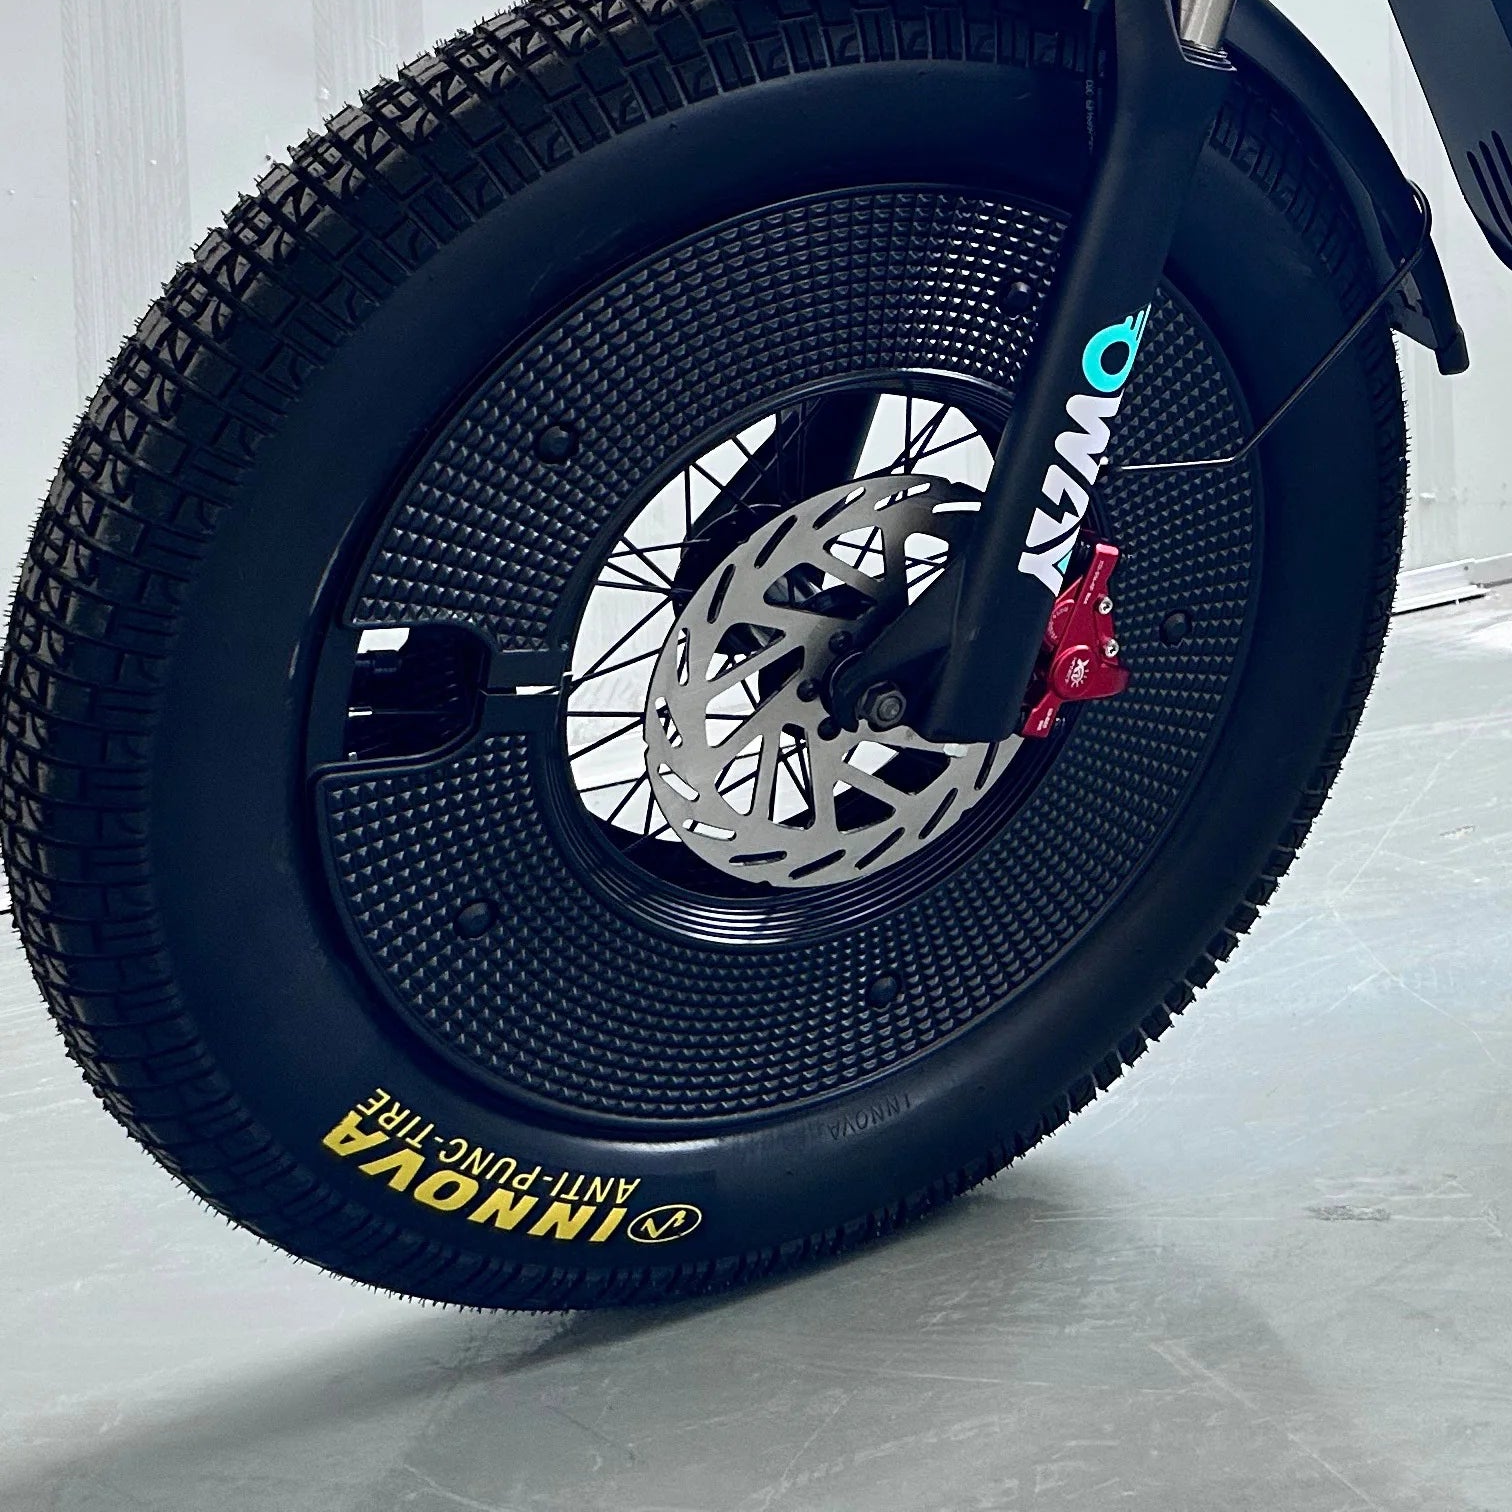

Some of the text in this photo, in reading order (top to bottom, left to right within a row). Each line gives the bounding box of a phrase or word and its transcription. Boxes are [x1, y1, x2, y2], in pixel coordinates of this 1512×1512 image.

[356, 1087, 641, 1204] ANTI-PUNC-TIRE
[826, 1092, 911, 1141] INNOVA
[323, 1109, 628, 1242] INNOVA
